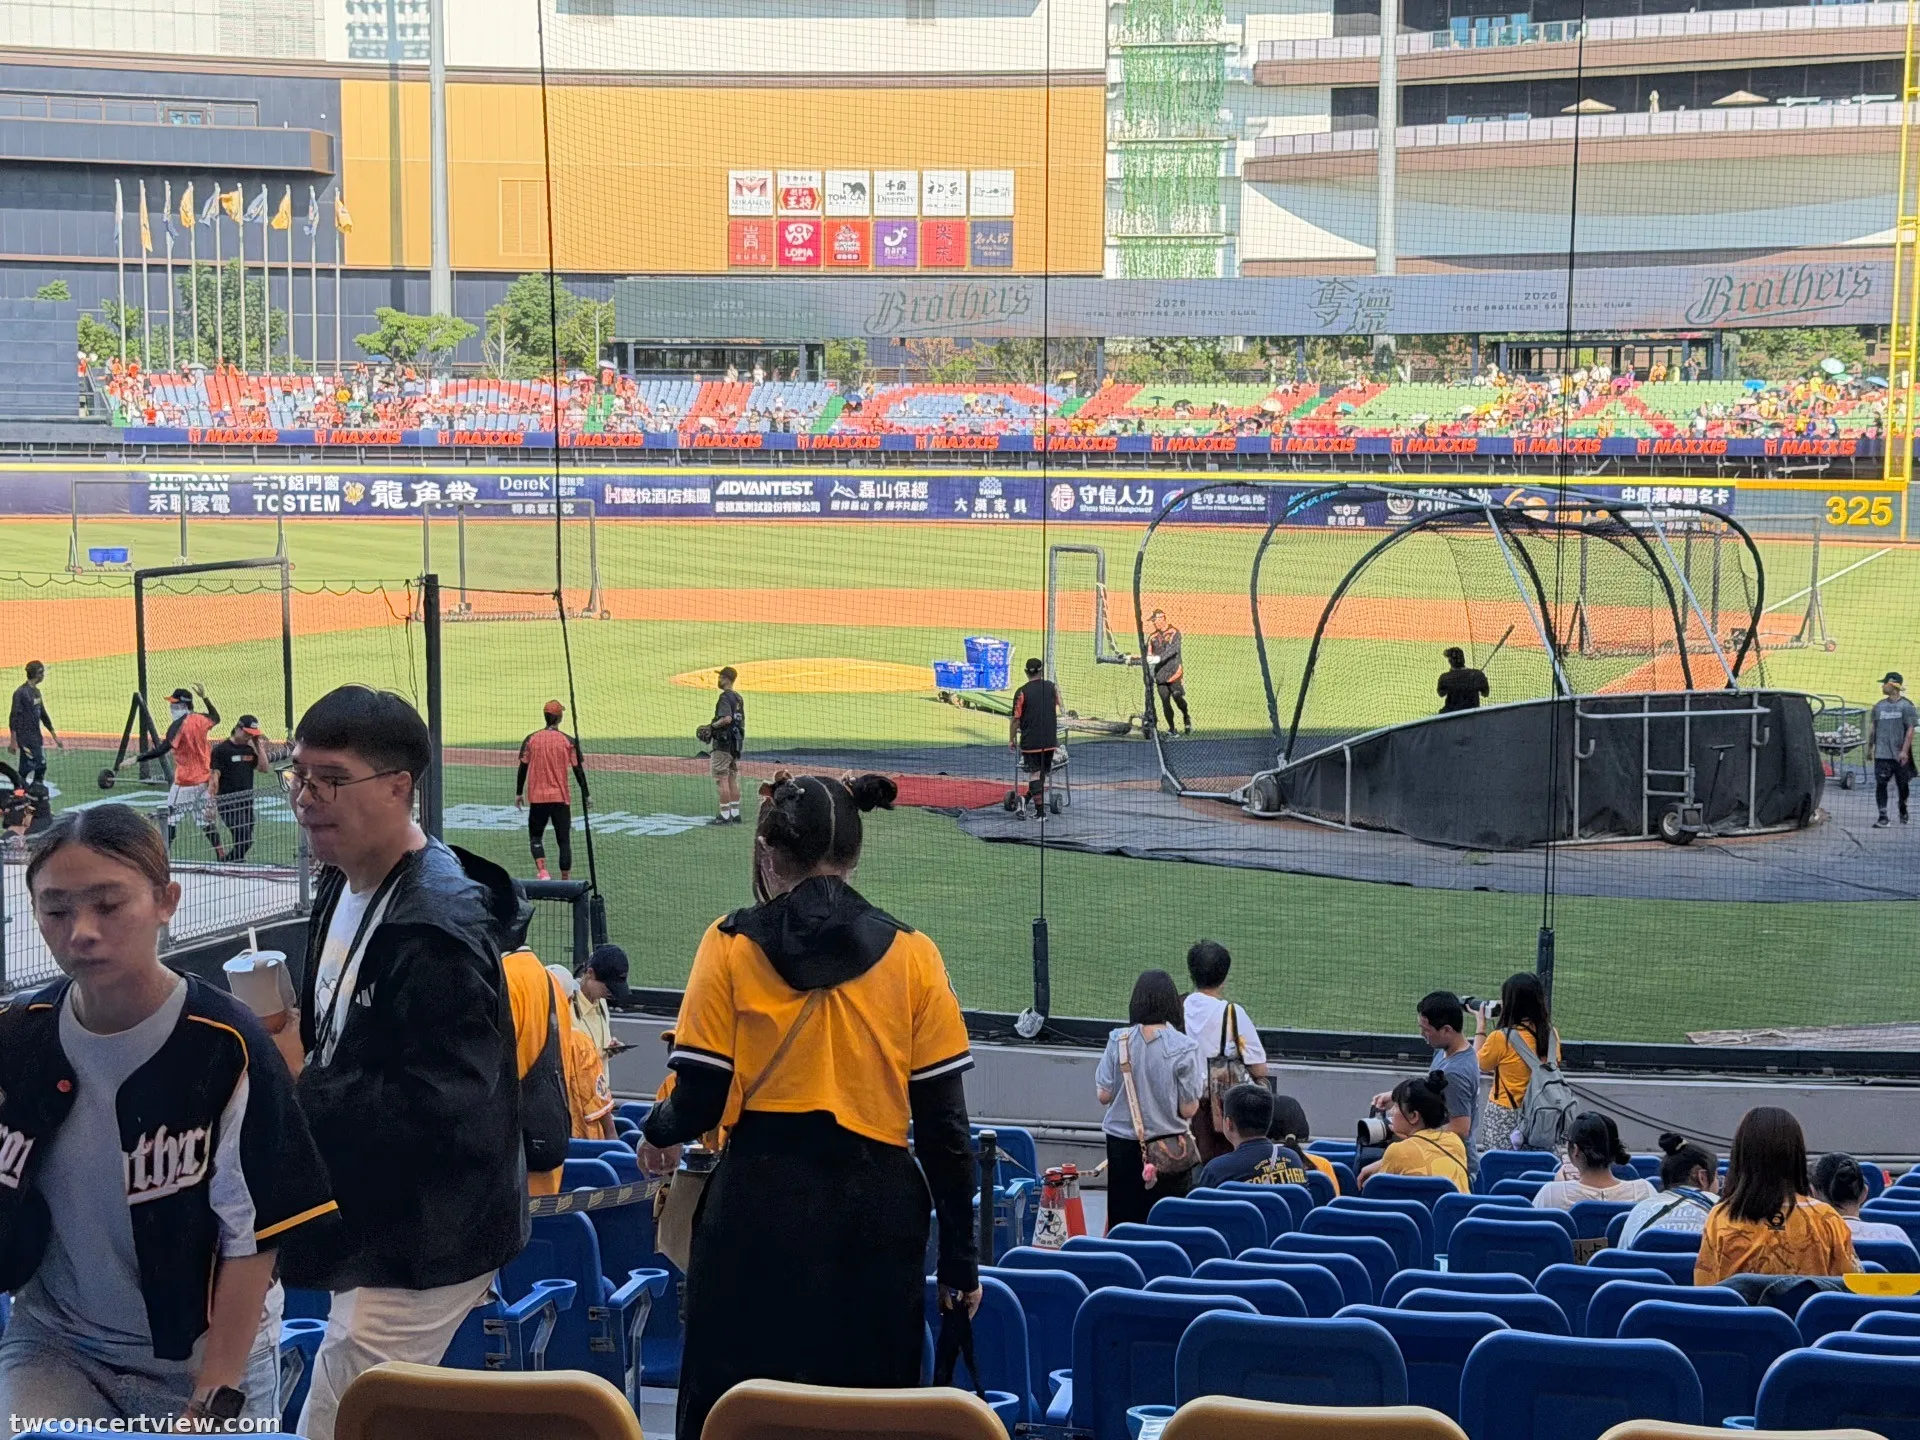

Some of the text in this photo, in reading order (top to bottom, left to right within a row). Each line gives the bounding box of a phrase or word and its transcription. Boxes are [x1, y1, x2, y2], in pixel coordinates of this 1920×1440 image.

[877, 192, 916, 204] Diversity
[785, 247, 814, 257] LOPIA
[885, 246, 907, 256] nara
[1524, 291, 1558, 301] 2026
[1684, 263, 1877, 326] Brothers
[863, 283, 1036, 335] Brothers
[1484, 303, 1539, 311] BROTHERS
[1544, 302, 1598, 310] BASBALL
[1116, 310, 1169, 318] BROTHERS
[205, 429, 279, 443] MAXXIS
[330, 430, 403, 444] MAXXIS
[453, 431, 524, 445] MAXXIS
[573, 433, 644, 448] MAXXIS
[694, 434, 763, 448] MAXXIS
[812, 435, 881, 449] MAXXIS
[930, 435, 999, 450] MAXXIS
[1048, 436, 1118, 451] MAXXIS
[1167, 438, 1237, 452] MAXXIS
[1286, 438, 1357, 452] MAXXIS
[1406, 438, 1478, 454] MAXXIS
[1653, 439, 1728, 455] MAXXIS
[1780, 440, 1857, 456] MAXXIS
[370, 480, 482, 509] 龍角散
[858, 480, 929, 499] 磊山保經
[1079, 485, 1154, 505] 守信人力
[954, 497, 1028, 513] 大漢家具
[1114, 505, 1154, 514] Manpower
[1825, 496, 1894, 526] 325
